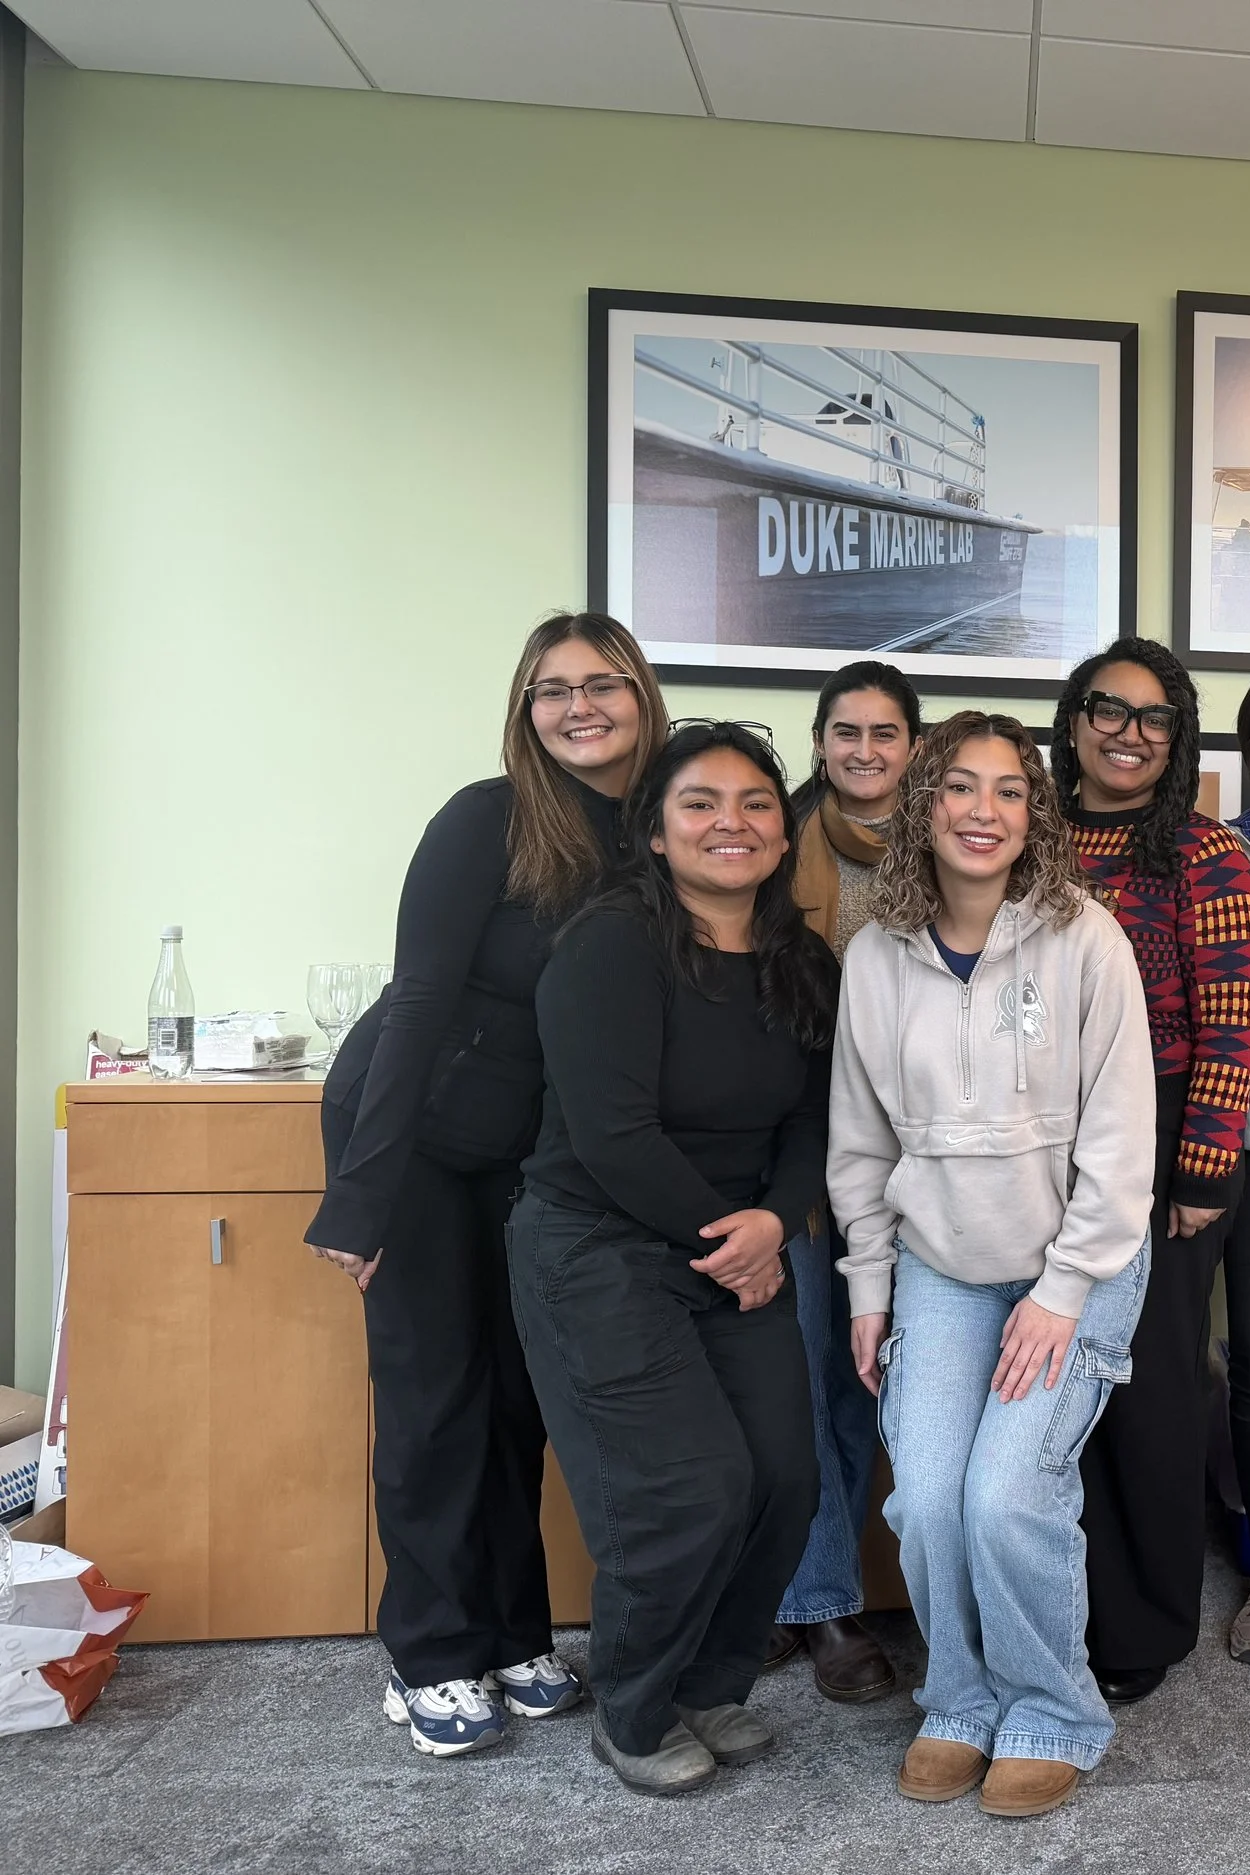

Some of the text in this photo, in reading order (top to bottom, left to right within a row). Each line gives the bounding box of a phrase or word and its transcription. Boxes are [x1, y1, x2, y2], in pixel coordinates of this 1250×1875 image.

[758, 496, 860, 576] DUKE
[870, 511, 944, 568] MARINE
[949, 521, 973, 564] LAB
